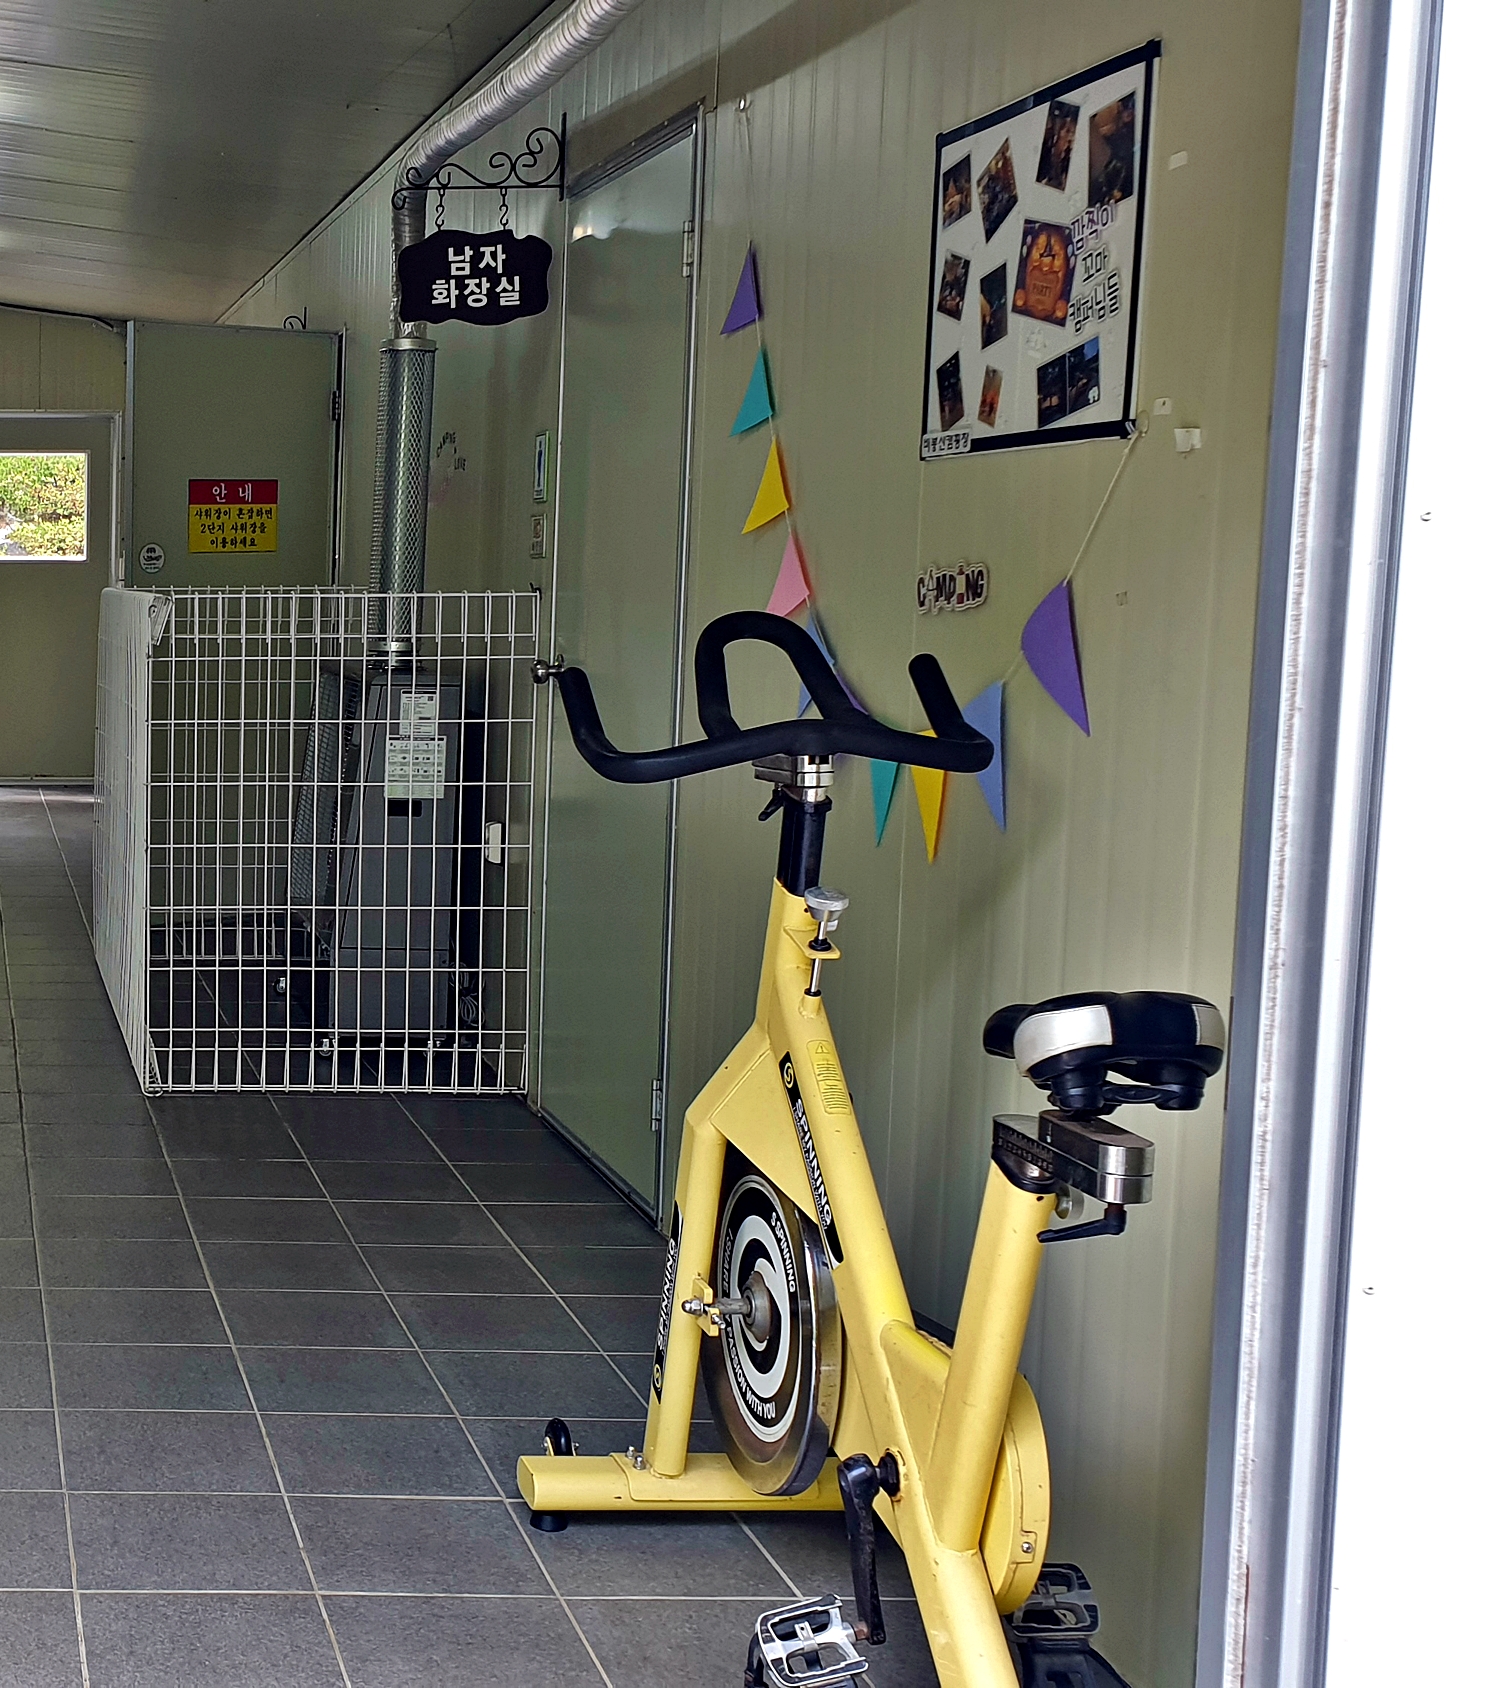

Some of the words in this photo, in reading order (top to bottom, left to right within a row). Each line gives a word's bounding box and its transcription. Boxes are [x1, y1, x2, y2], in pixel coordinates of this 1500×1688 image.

[1070, 201, 1115, 252] 깜찍이
[448, 244, 506, 276] 남자
[1082, 247, 1108, 283] 꼬마
[431, 275, 520, 309] 화장실
[1068, 272, 1119, 333] 캠퍼님들
[200, 522, 225, 535] 2단지
[210, 536, 258, 549] 이용하세요
[917, 565, 984, 609] CAMPING
[796, 1098, 832, 1226] SPINNING
[722, 1236, 732, 1293] SHARE
[775, 1220, 796, 1293] SPINNING
[657, 1238, 676, 1350] SPINNING
[726, 1326, 747, 1393] PASSION
[746, 1386, 763, 1417] WITH
[762, 1401, 776, 1420] YOU
